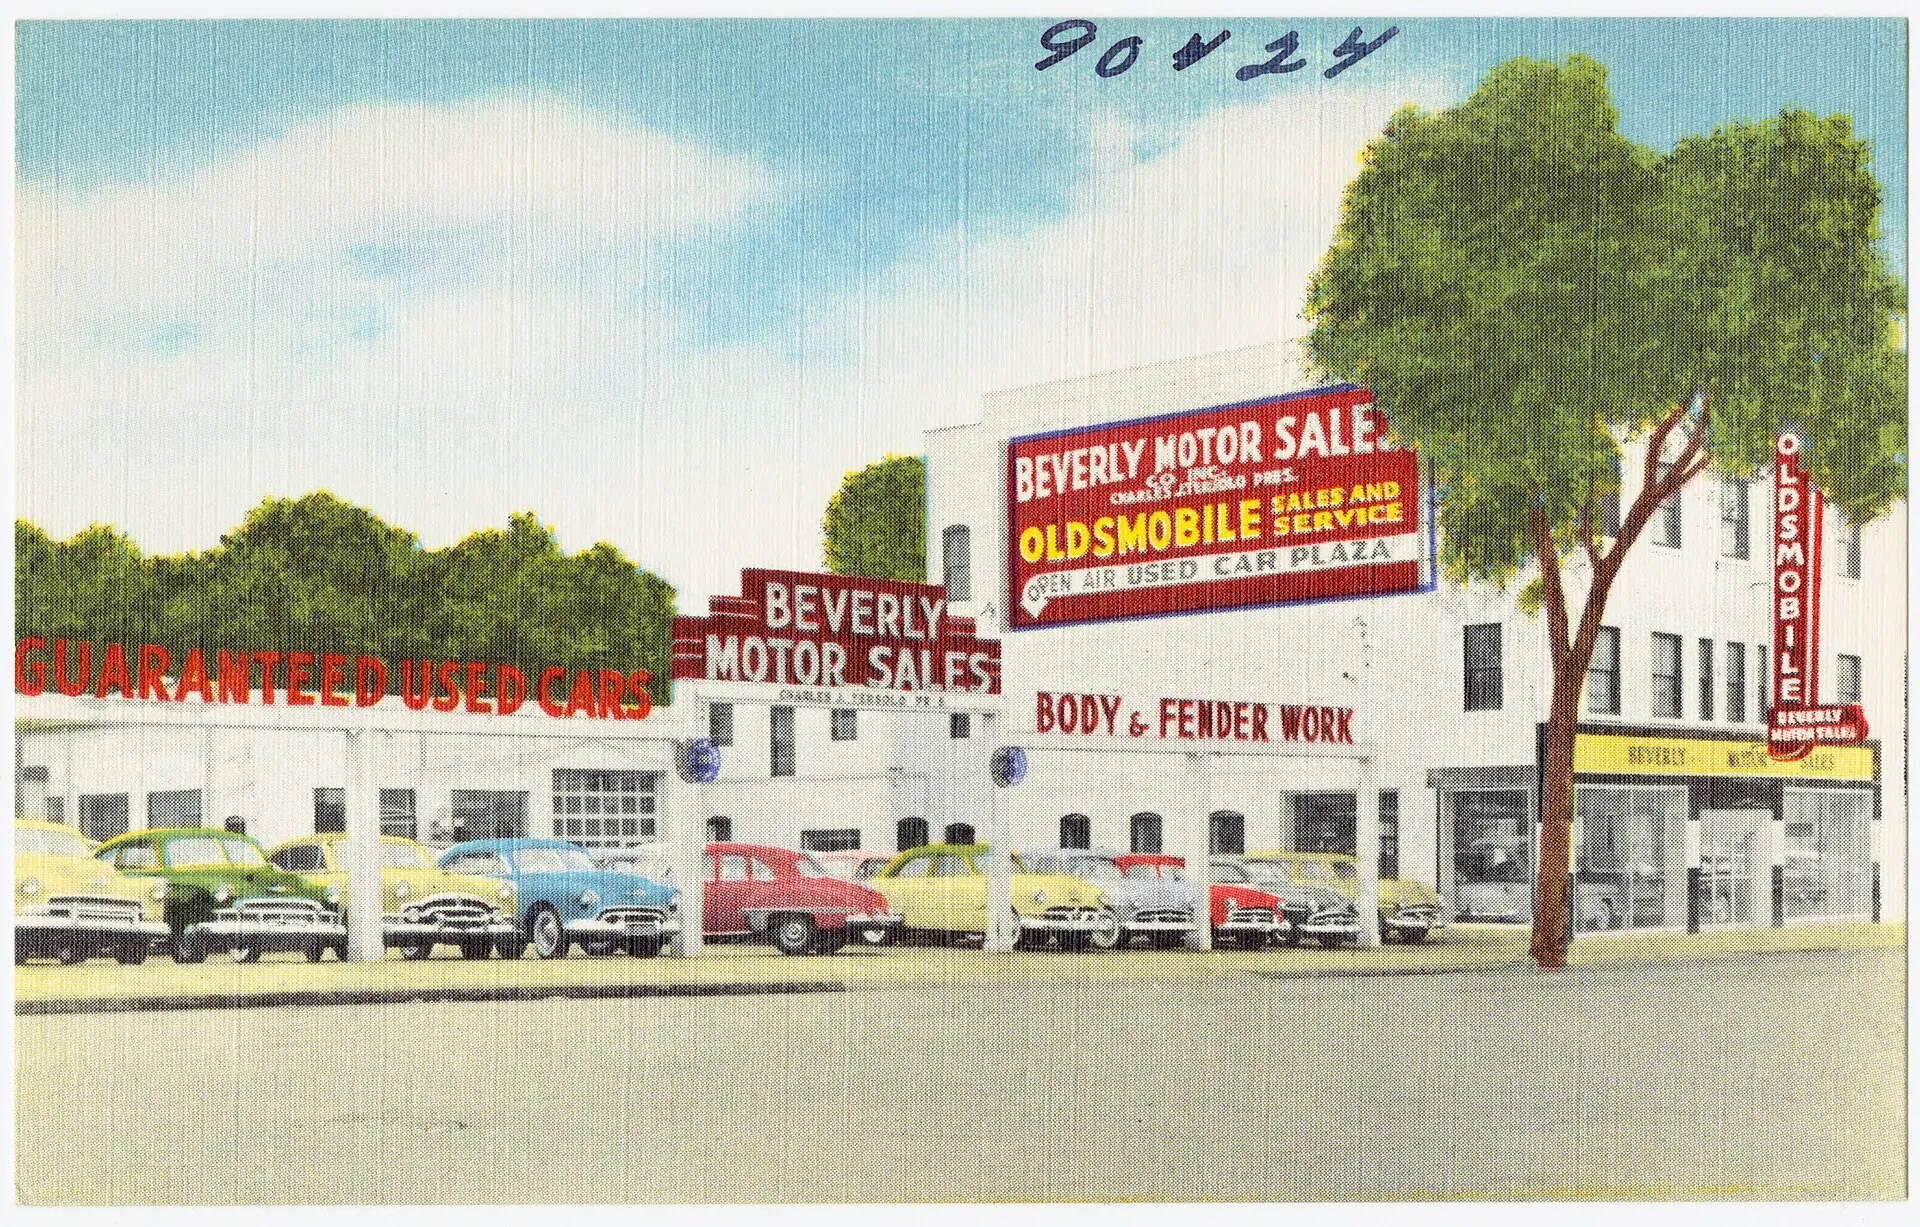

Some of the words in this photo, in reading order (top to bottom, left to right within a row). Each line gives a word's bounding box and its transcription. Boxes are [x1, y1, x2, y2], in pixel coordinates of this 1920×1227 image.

[1015, 437, 1146, 503] BEVERLY
[1155, 420, 1263, 474] MOTOR
[1274, 402, 1399, 461] SALE
[1271, 486, 1345, 514] SALES
[1349, 480, 1400, 503] AND
[1273, 502, 1404, 536] SERVICE
[1019, 499, 1262, 563] OLDSMOBILE
[1027, 572, 1071, 602] OPEN
[1082, 568, 1116, 591] AIR
[1127, 559, 1198, 587] USED
[1213, 546, 1277, 577] CAR
[1290, 537, 1394, 568] PLAZA
[1776, 431, 1805, 702] OLDSMOBILE
[765, 581, 947, 642] BEVERLY
[15, 636, 387, 709] GUARANTEED
[402, 659, 527, 716] USED
[536, 666, 654, 721] CARS
[705, 634, 847, 688] MOTOR
[866, 645, 994, 695] SALES
[1036, 690, 1123, 737] BODY
[1129, 710, 1150, 738] &
[1159, 697, 1269, 743] FENDER
[1280, 704, 1355, 745] WORK
[1627, 745, 1687, 766] BEVERLY
